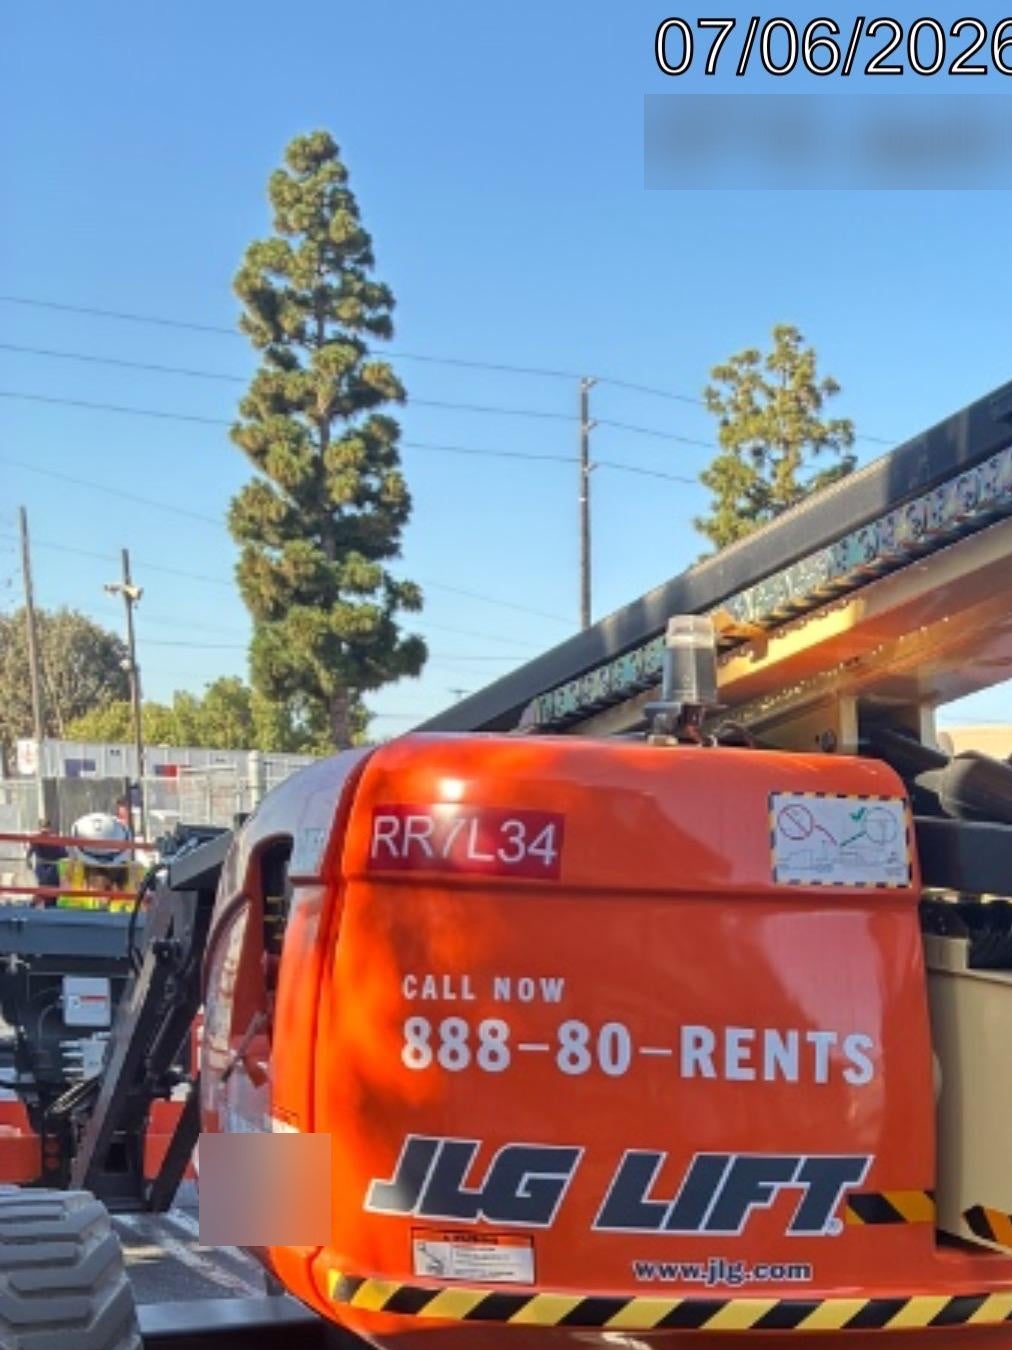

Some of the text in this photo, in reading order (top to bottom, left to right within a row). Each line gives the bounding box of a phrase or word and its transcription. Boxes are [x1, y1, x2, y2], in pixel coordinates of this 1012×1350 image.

[371, 815, 556, 865] RR7L34
[402, 974, 565, 1003] CALL NOW
[401, 1016, 875, 1084] 888-80-RENTS
[364, 1133, 584, 1228] JLG
[632, 1258, 812, 1286] www.jlg.com
